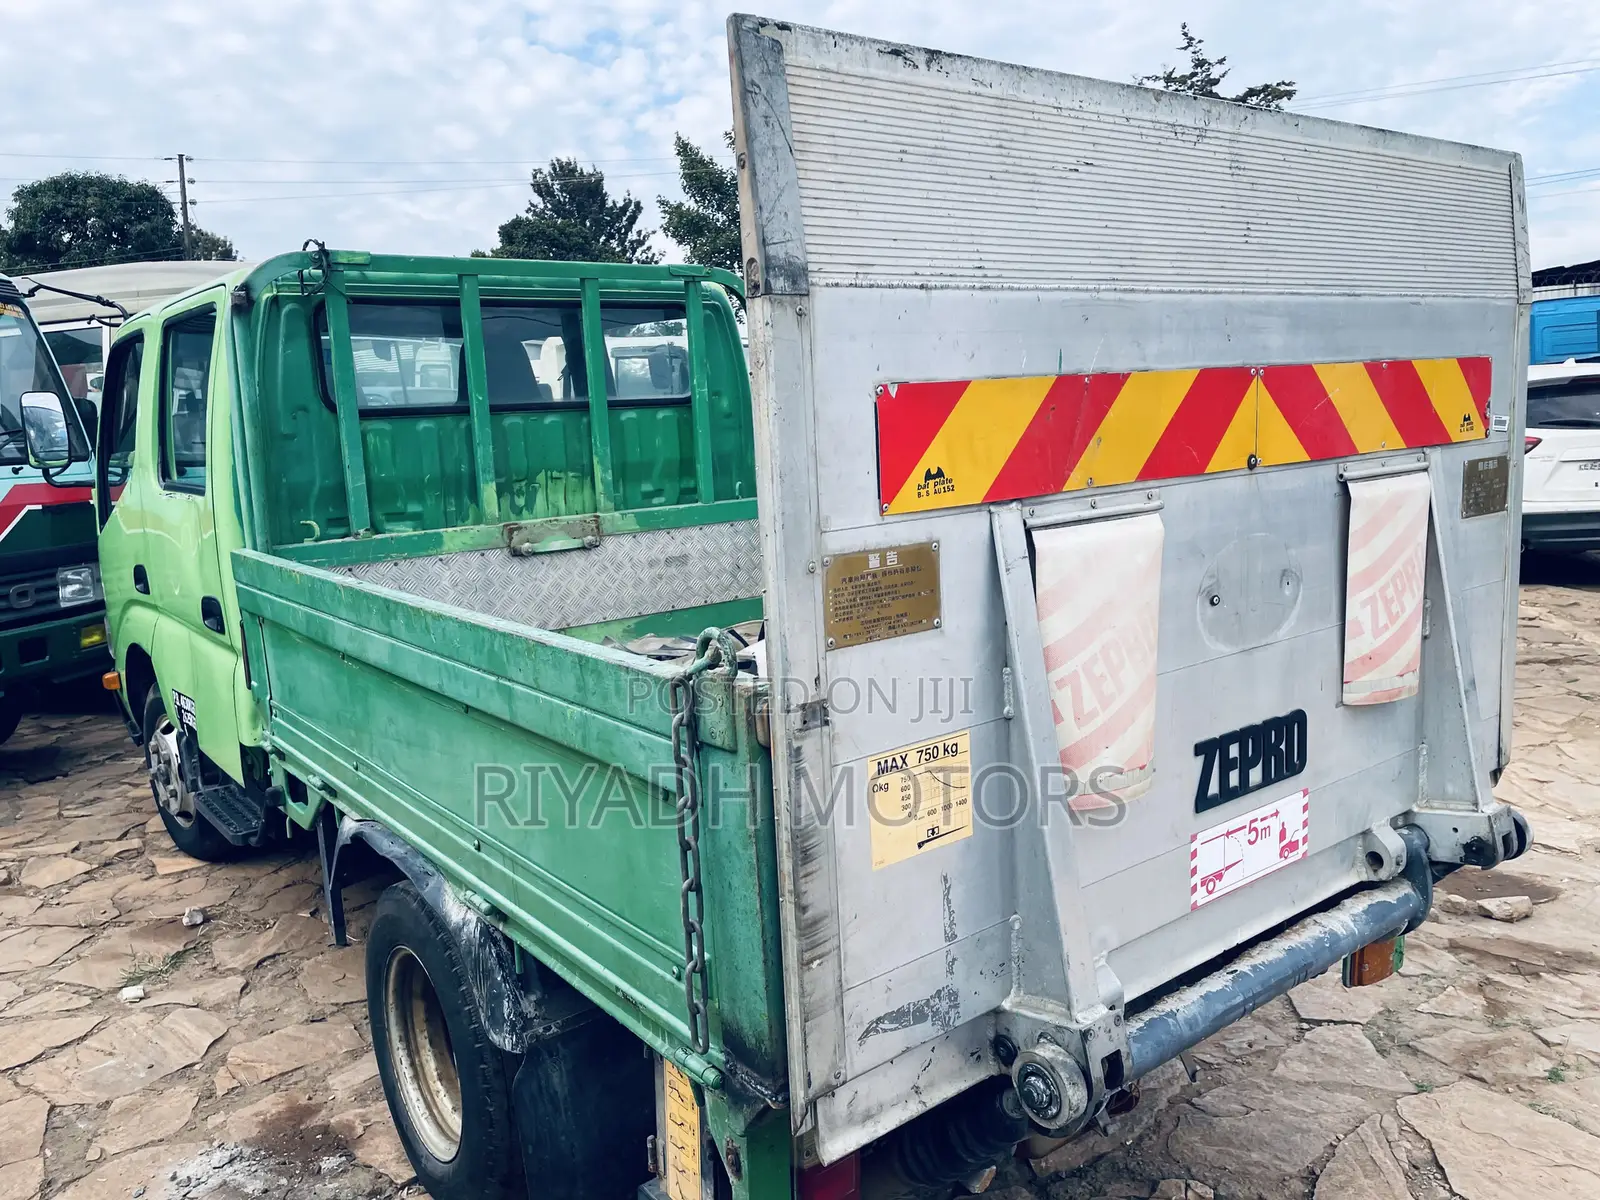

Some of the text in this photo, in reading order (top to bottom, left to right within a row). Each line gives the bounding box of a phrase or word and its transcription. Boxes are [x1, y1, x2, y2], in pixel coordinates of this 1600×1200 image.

[917, 477, 953, 491] bat plate
[877, 741, 958, 776] MAX 750 kg
[1193, 708, 1308, 815] ZEPRO
[900, 785, 911, 793] 600
[901, 803, 911, 811] 300
